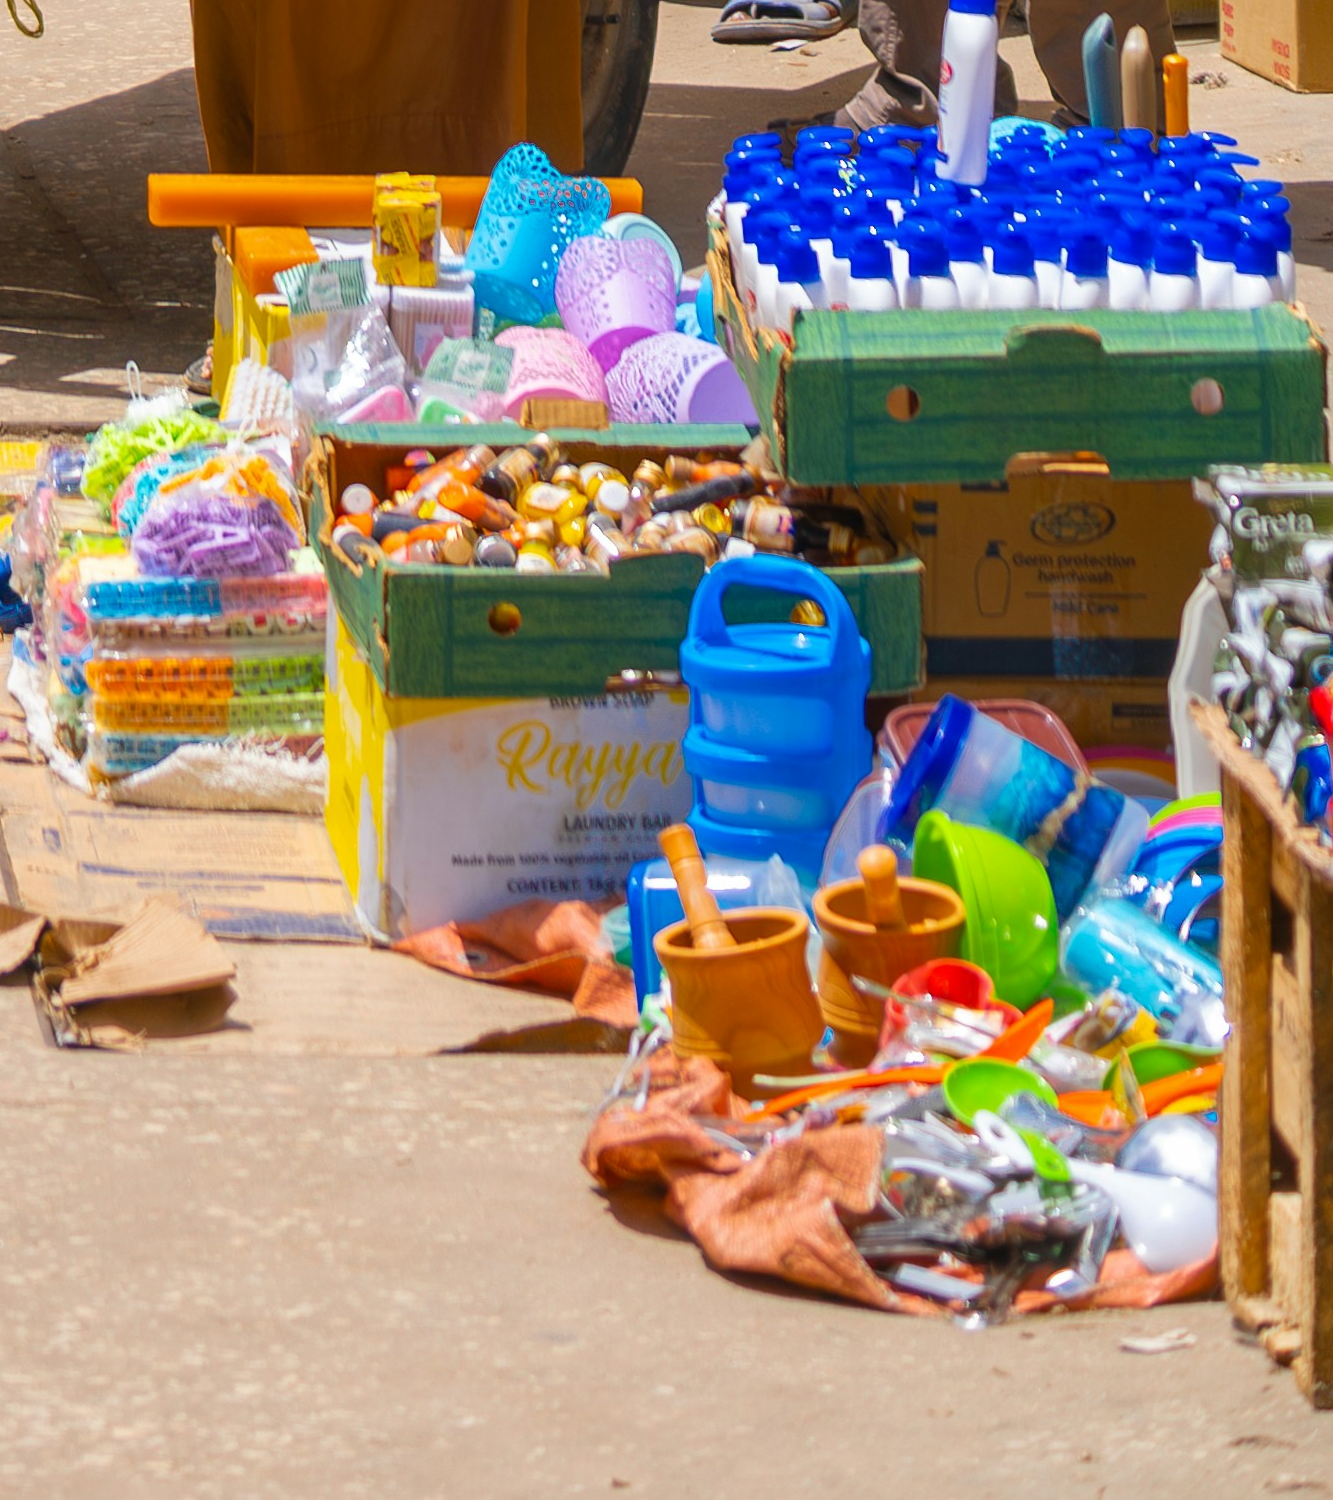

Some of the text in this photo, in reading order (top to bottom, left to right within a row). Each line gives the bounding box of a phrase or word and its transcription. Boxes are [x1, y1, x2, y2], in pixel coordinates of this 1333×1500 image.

[1057, 552, 1136, 570] protection
[1038, 567, 1114, 584] handwash
[1087, 600, 1120, 615] Care
[496, 719, 684, 812] Rayya
[563, 811, 672, 831] LAUNDRY BAR
[451, 854, 485, 868] Made
[486, 852, 516, 868] from
